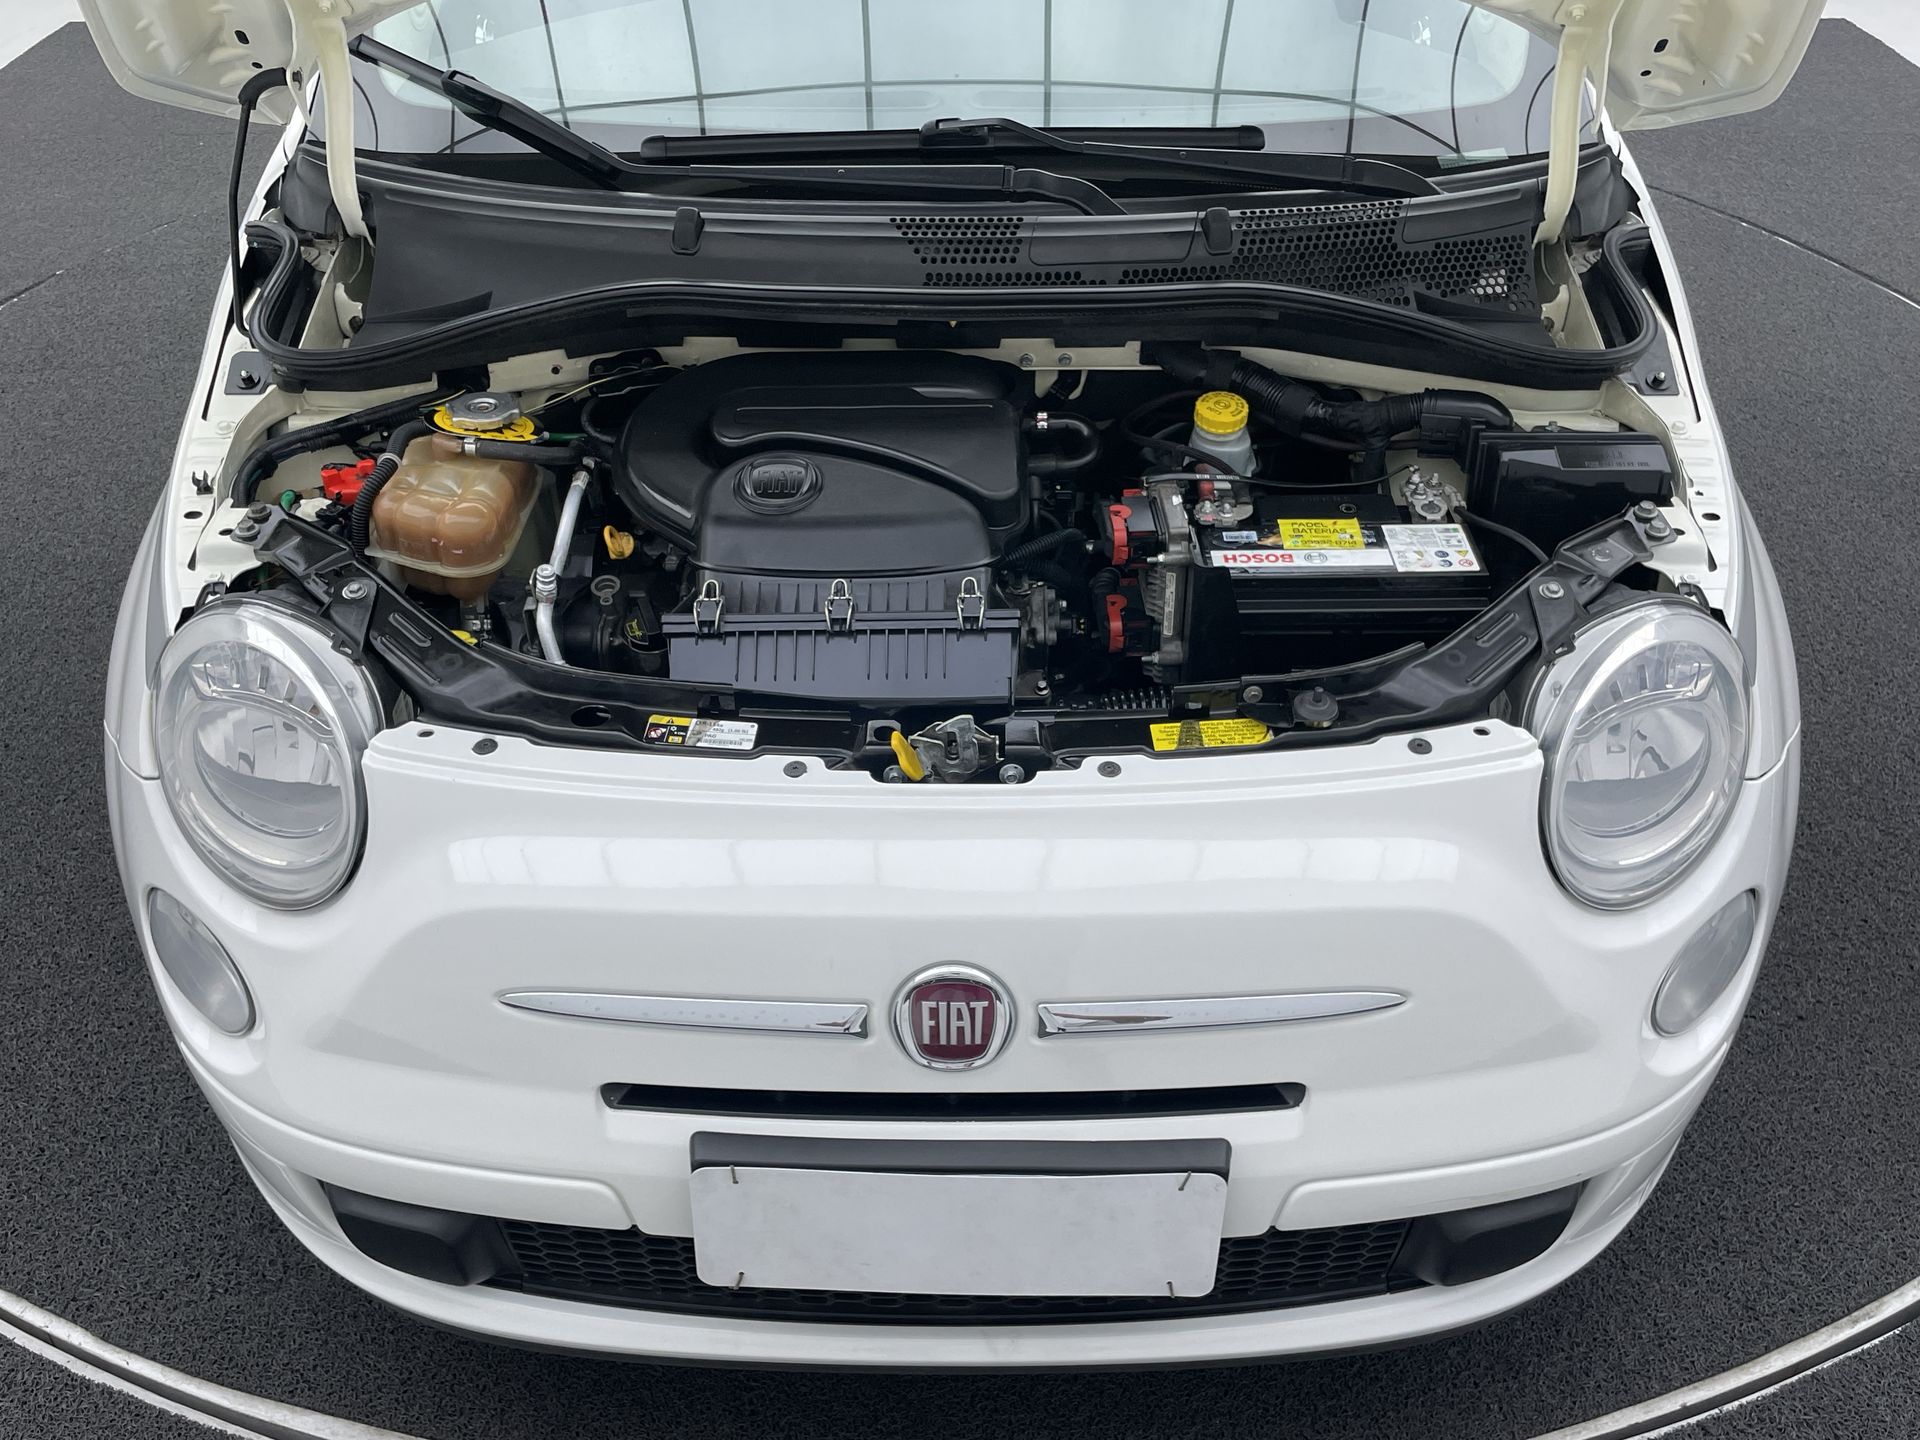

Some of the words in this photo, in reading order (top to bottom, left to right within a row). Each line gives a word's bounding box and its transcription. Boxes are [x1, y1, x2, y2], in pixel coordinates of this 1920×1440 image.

[757, 470, 803, 493] FIAT
[1292, 527, 1348, 535] BATERIAS
[1223, 553, 1294, 563] BOSCH
[921, 1000, 989, 1045] FIAT
